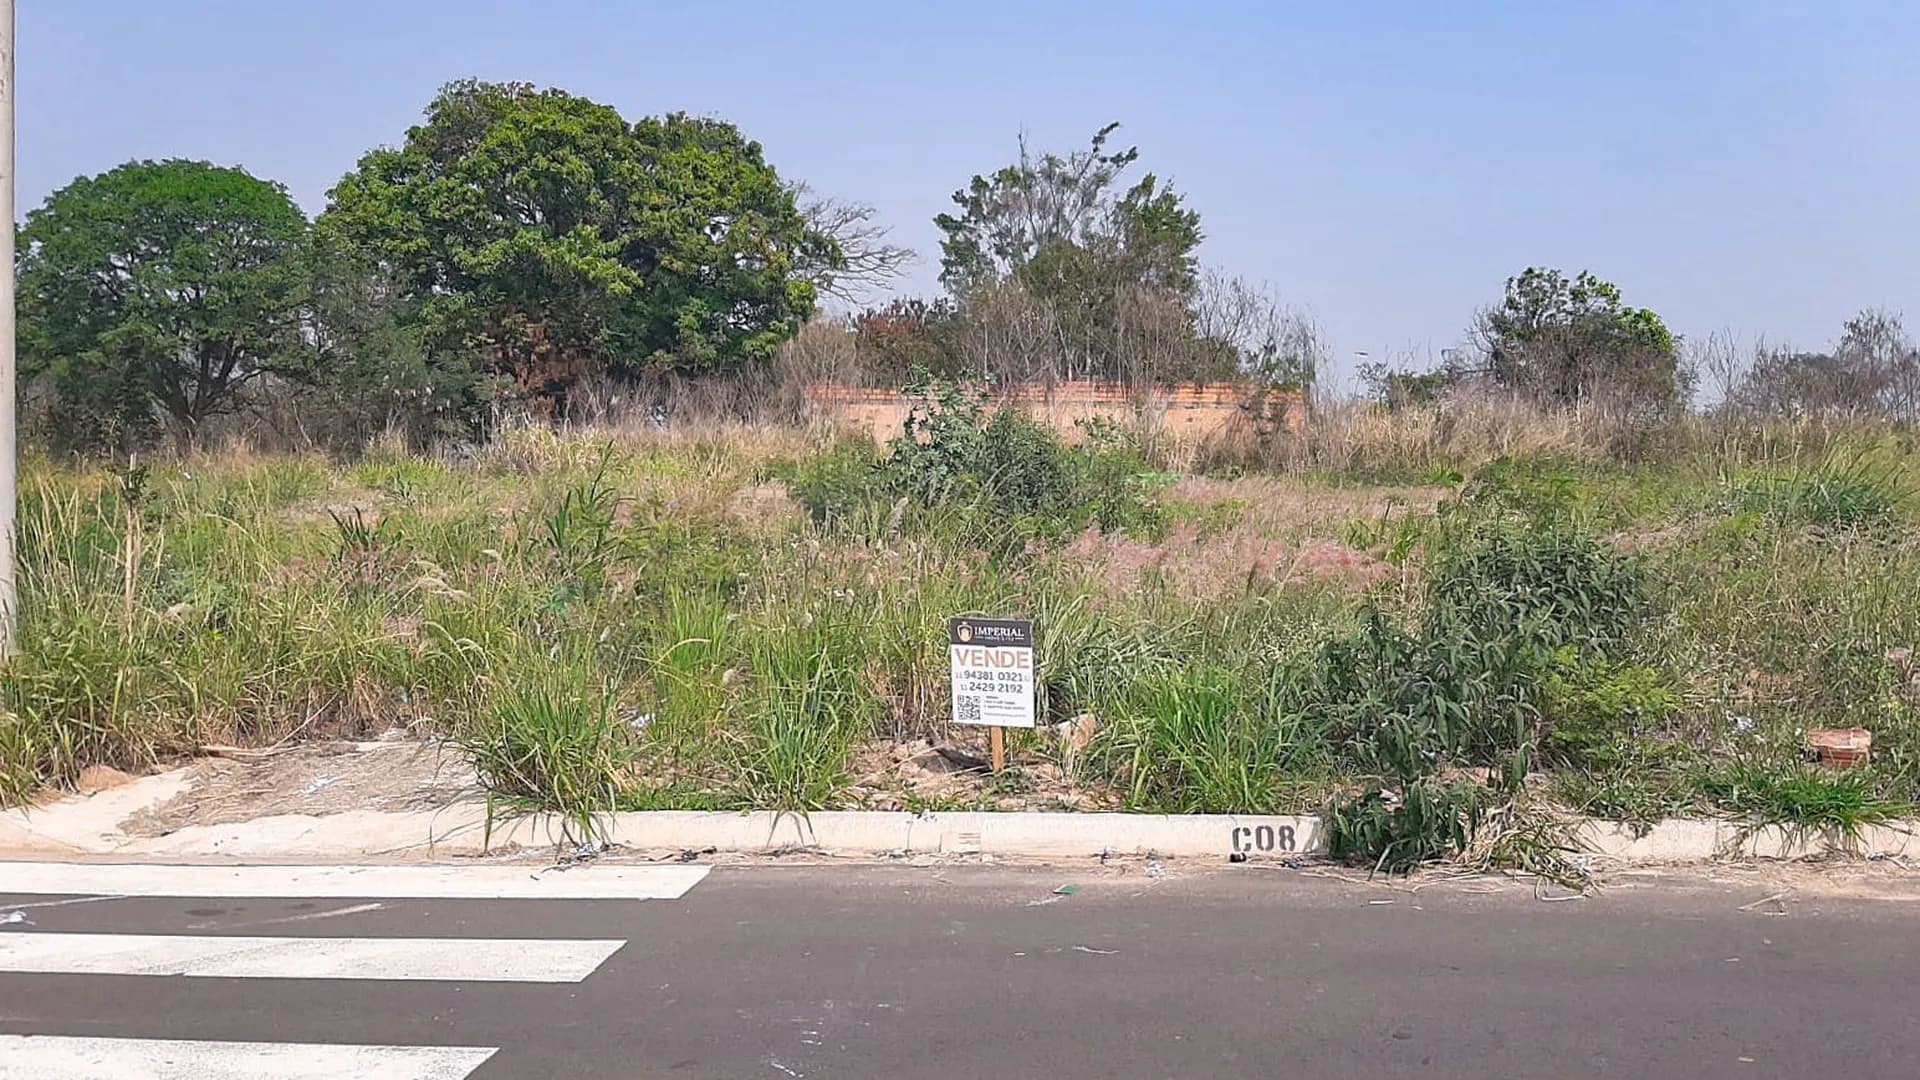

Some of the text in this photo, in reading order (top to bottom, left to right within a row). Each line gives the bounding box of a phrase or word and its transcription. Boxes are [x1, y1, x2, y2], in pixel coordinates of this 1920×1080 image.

[974, 626, 1025, 637] IMPERIAL
[955, 648, 1030, 669] VENDE
[963, 670, 994, 681] 94381
[997, 671, 1023, 682] 0321
[969, 681, 995, 692] 2429
[997, 682, 1023, 694] 2192
